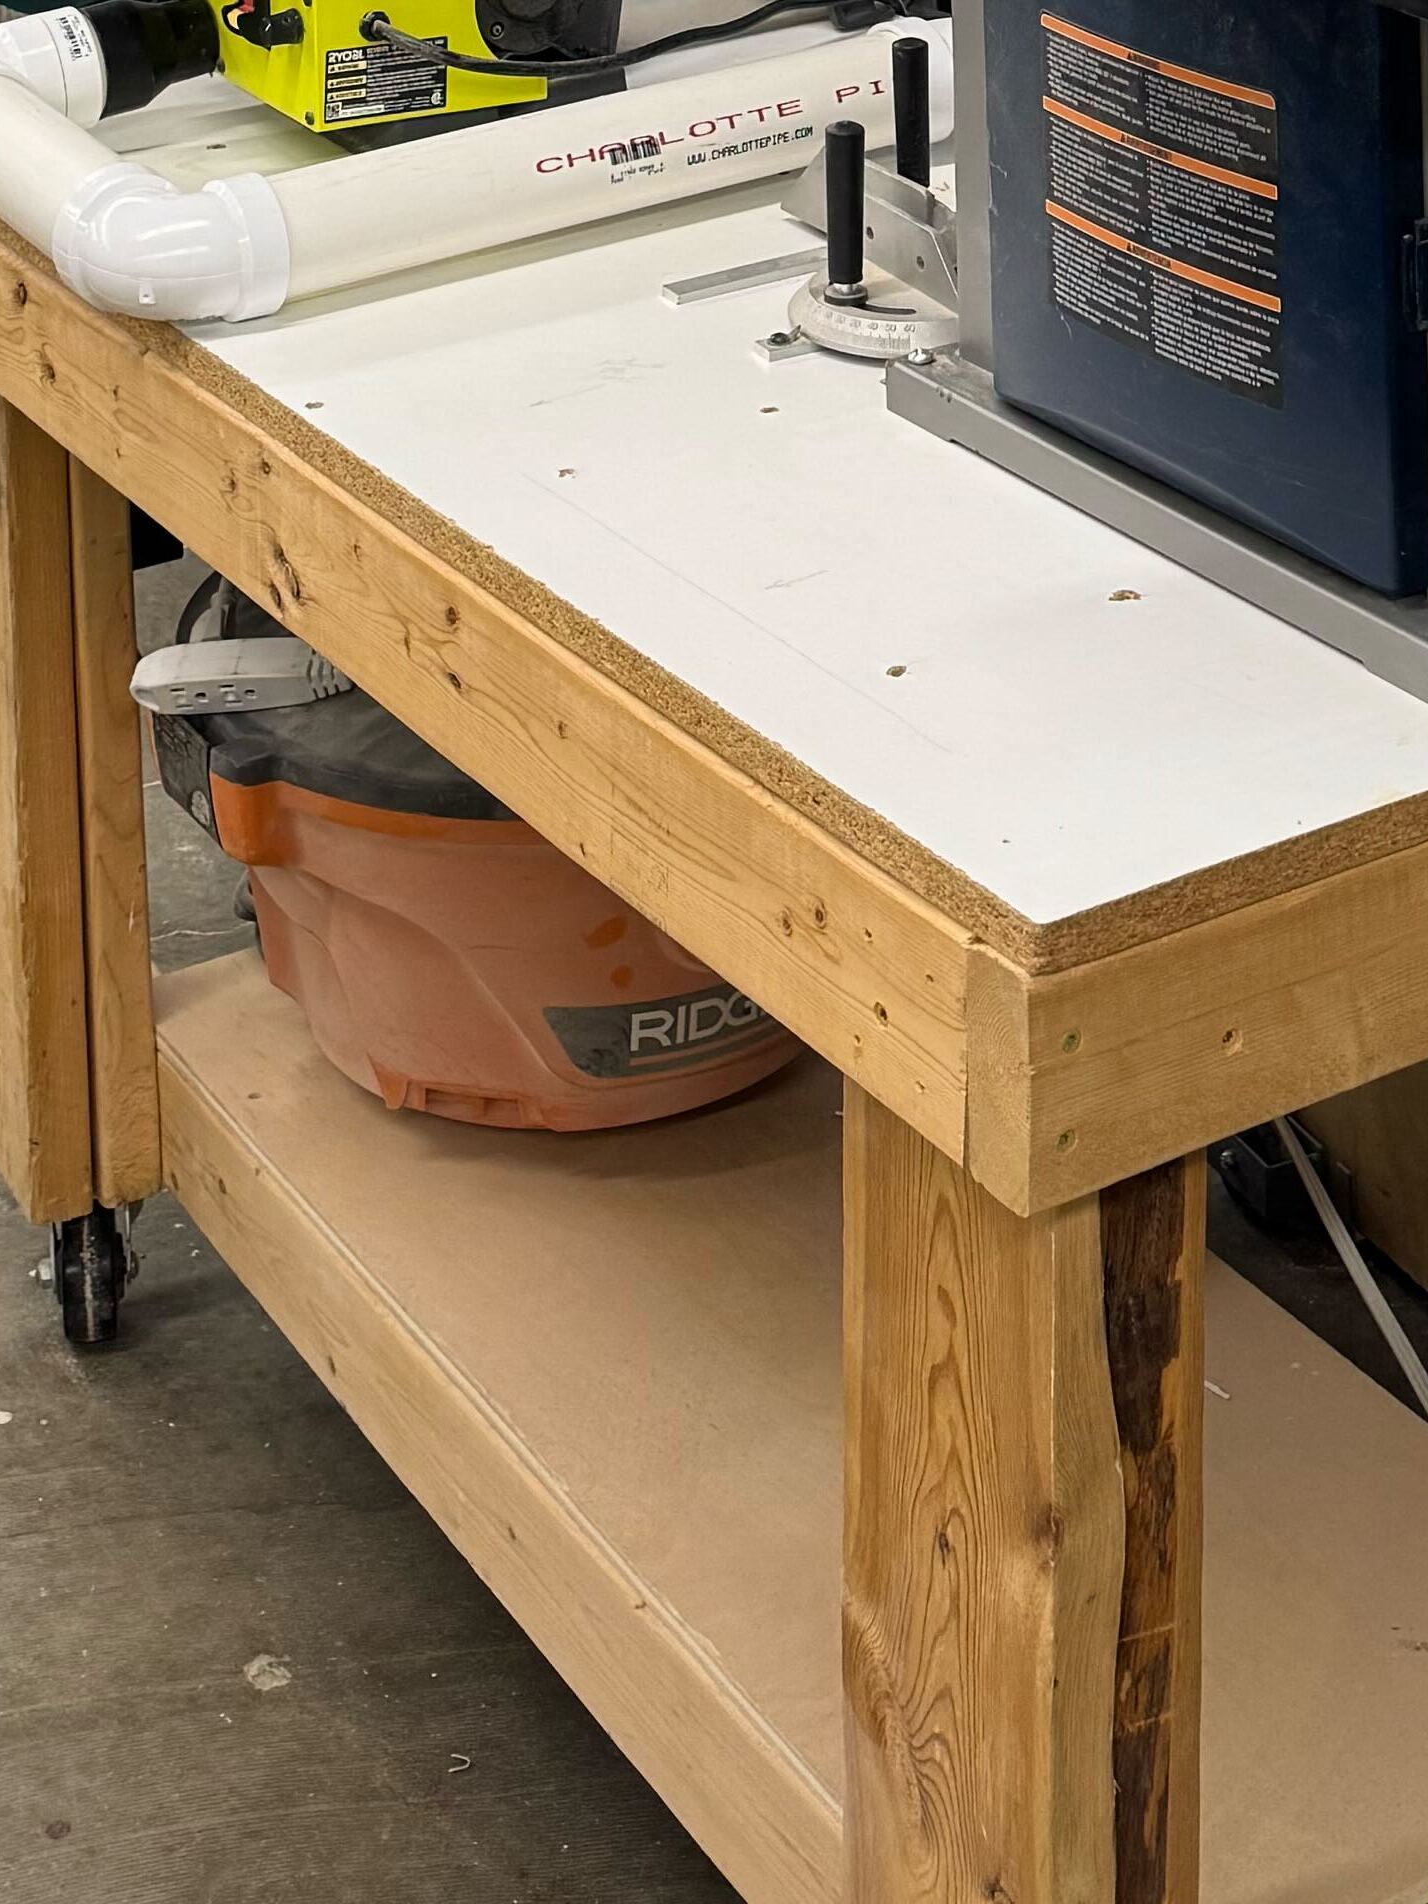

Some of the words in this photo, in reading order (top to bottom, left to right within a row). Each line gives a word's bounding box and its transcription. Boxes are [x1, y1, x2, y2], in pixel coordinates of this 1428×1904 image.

[328, 49, 366, 64] RYOBI
[535, 98, 804, 174] CHARLOTTE
[836, 80, 886, 104] PI
[629, 992, 765, 1053] RIDG
